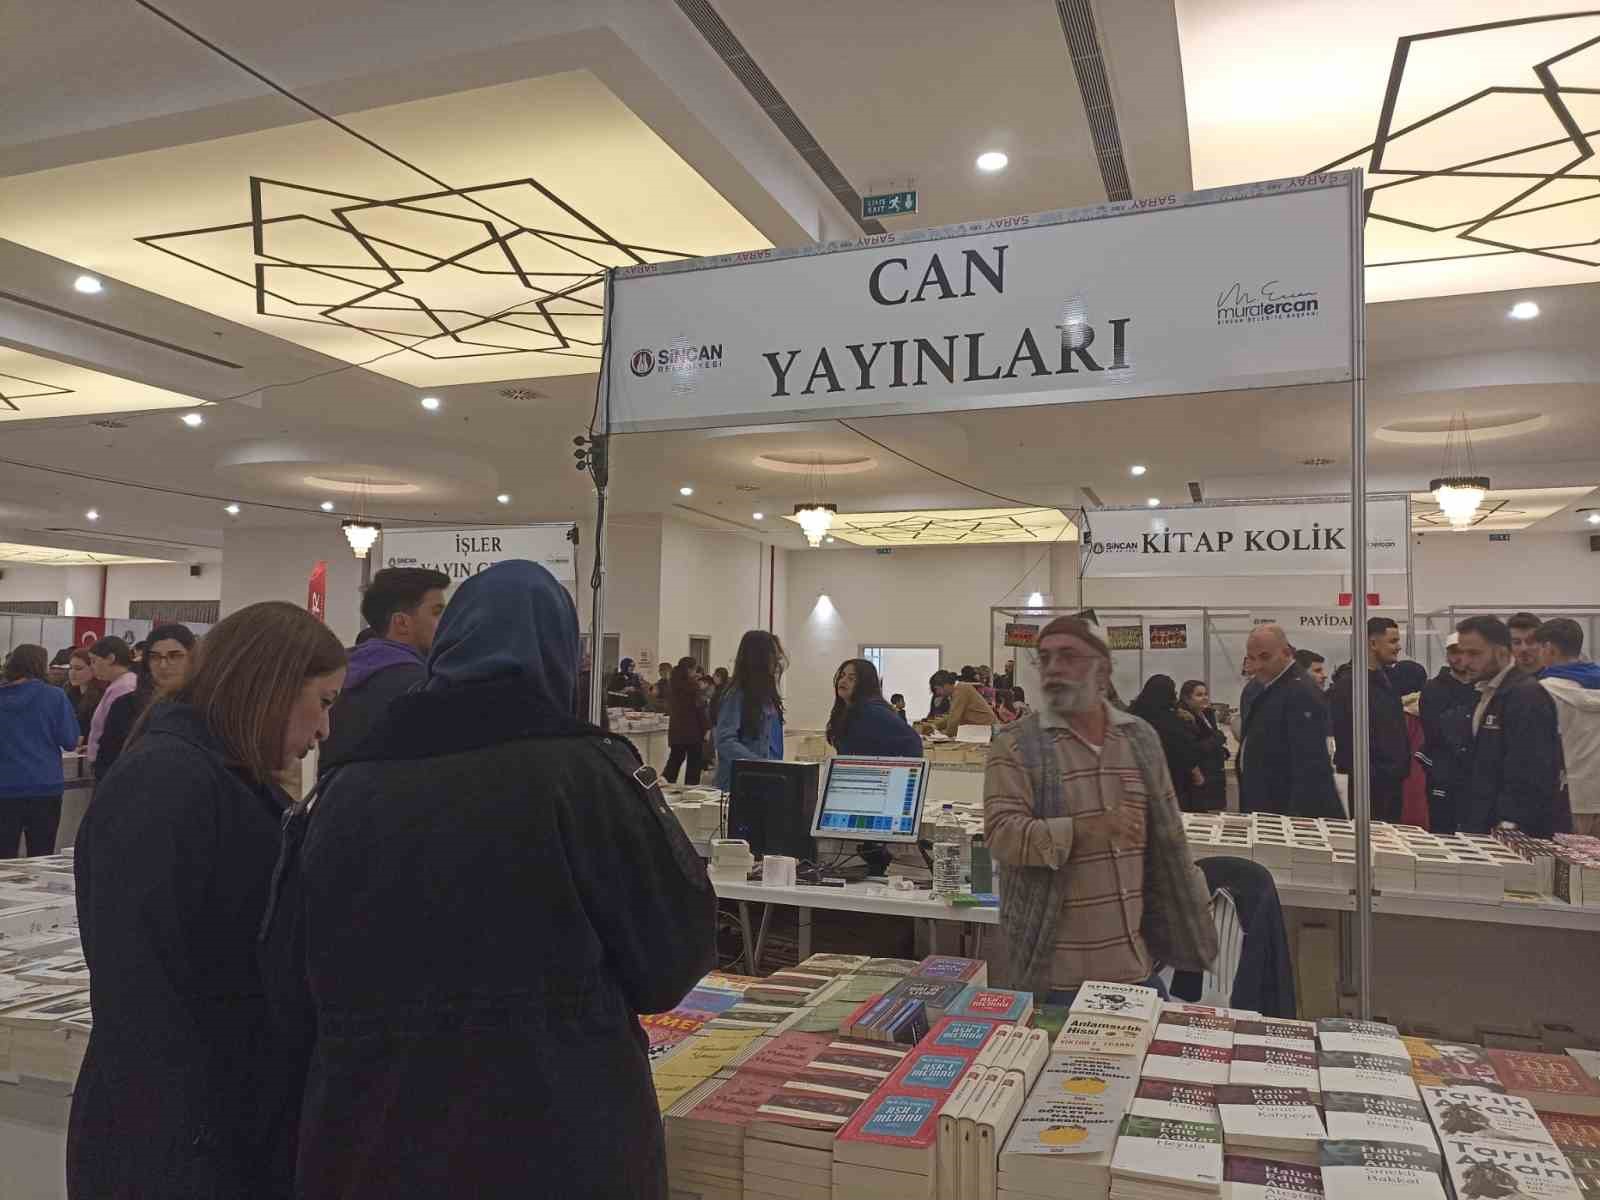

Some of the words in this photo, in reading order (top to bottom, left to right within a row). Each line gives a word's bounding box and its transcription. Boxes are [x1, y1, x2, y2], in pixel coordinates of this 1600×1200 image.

[868, 245, 1007, 305] CAN
[763, 317, 1132, 398] YAYINLARI
[456, 533, 502, 556] İŞLER
[1142, 527, 1233, 554] KİTAP
[1244, 522, 1346, 551] KOLİK
[1448, 1140, 1560, 1166] Tarık
